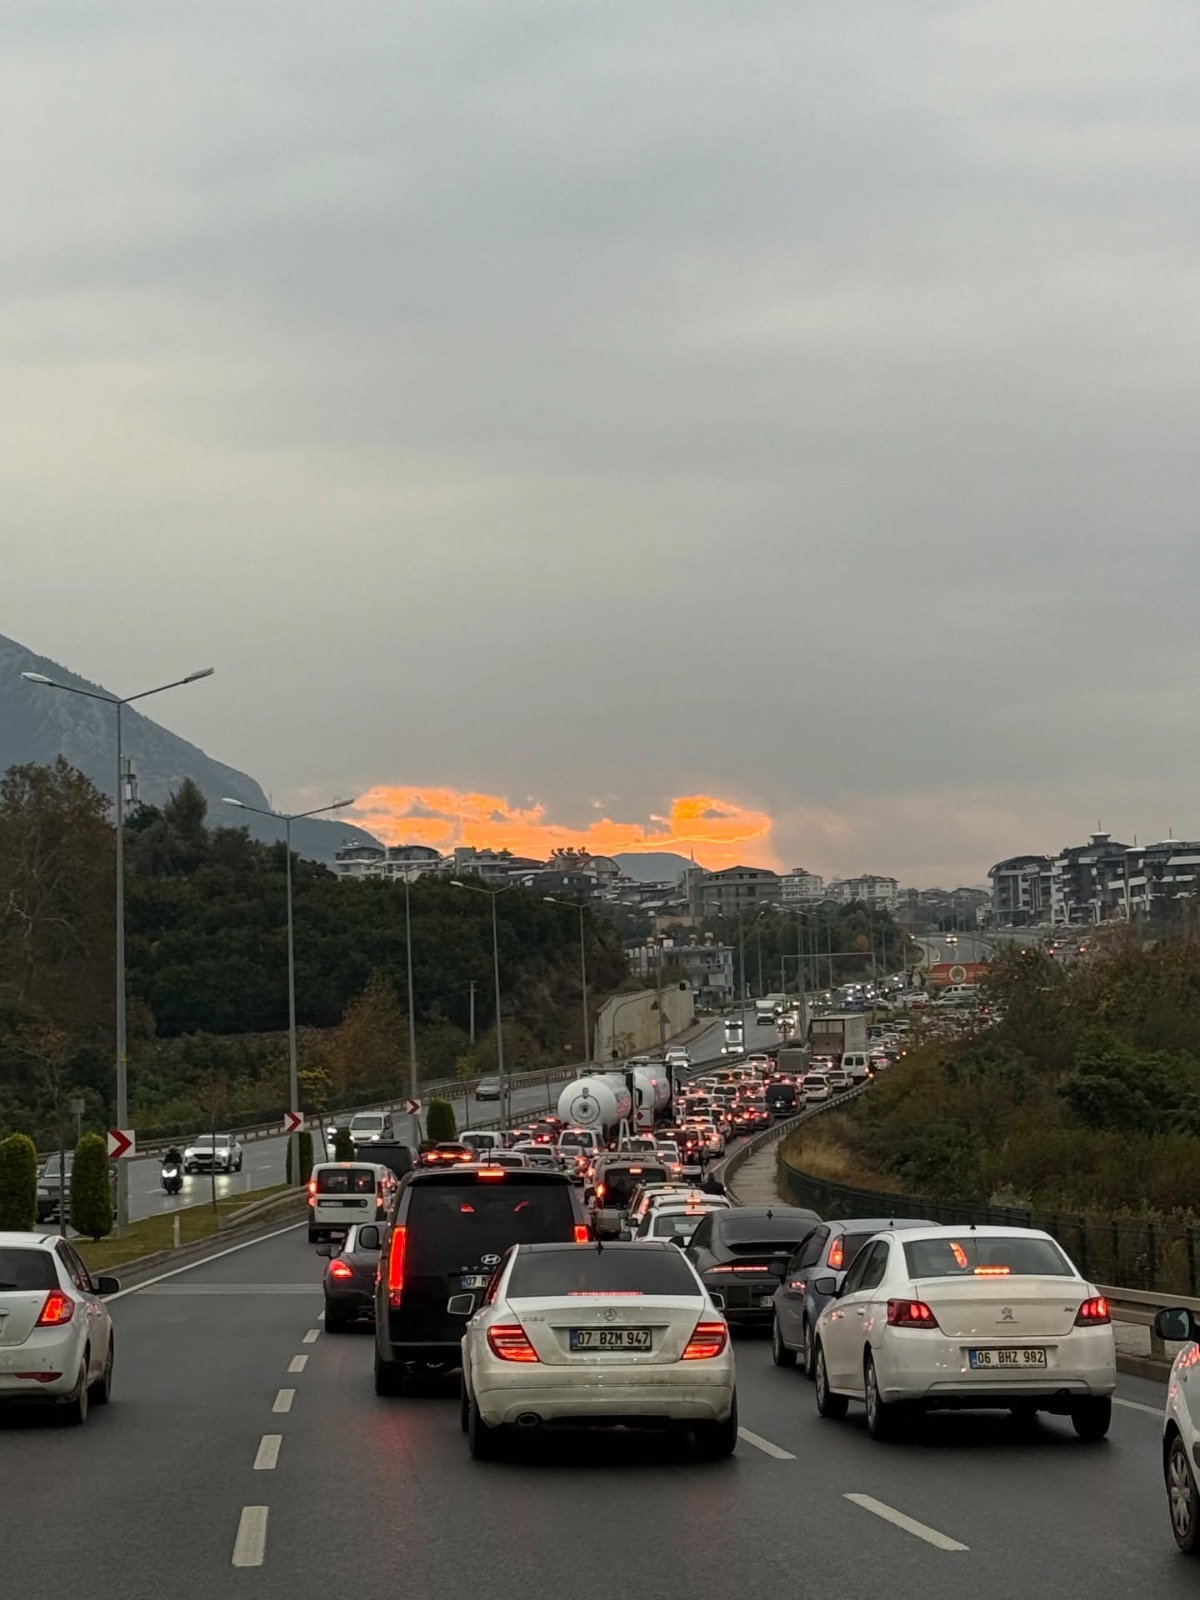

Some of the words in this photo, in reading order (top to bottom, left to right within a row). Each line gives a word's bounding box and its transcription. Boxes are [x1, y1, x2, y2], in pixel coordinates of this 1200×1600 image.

[466, 1276, 477, 1286] 07
[578, 1331, 593, 1346] 07
[599, 1331, 623, 1345] BZM
[627, 1331, 650, 1345] 947
[977, 1352, 991, 1364] 06
[998, 1351, 1019, 1364] BHZ
[1023, 1350, 1044, 1363] 982
